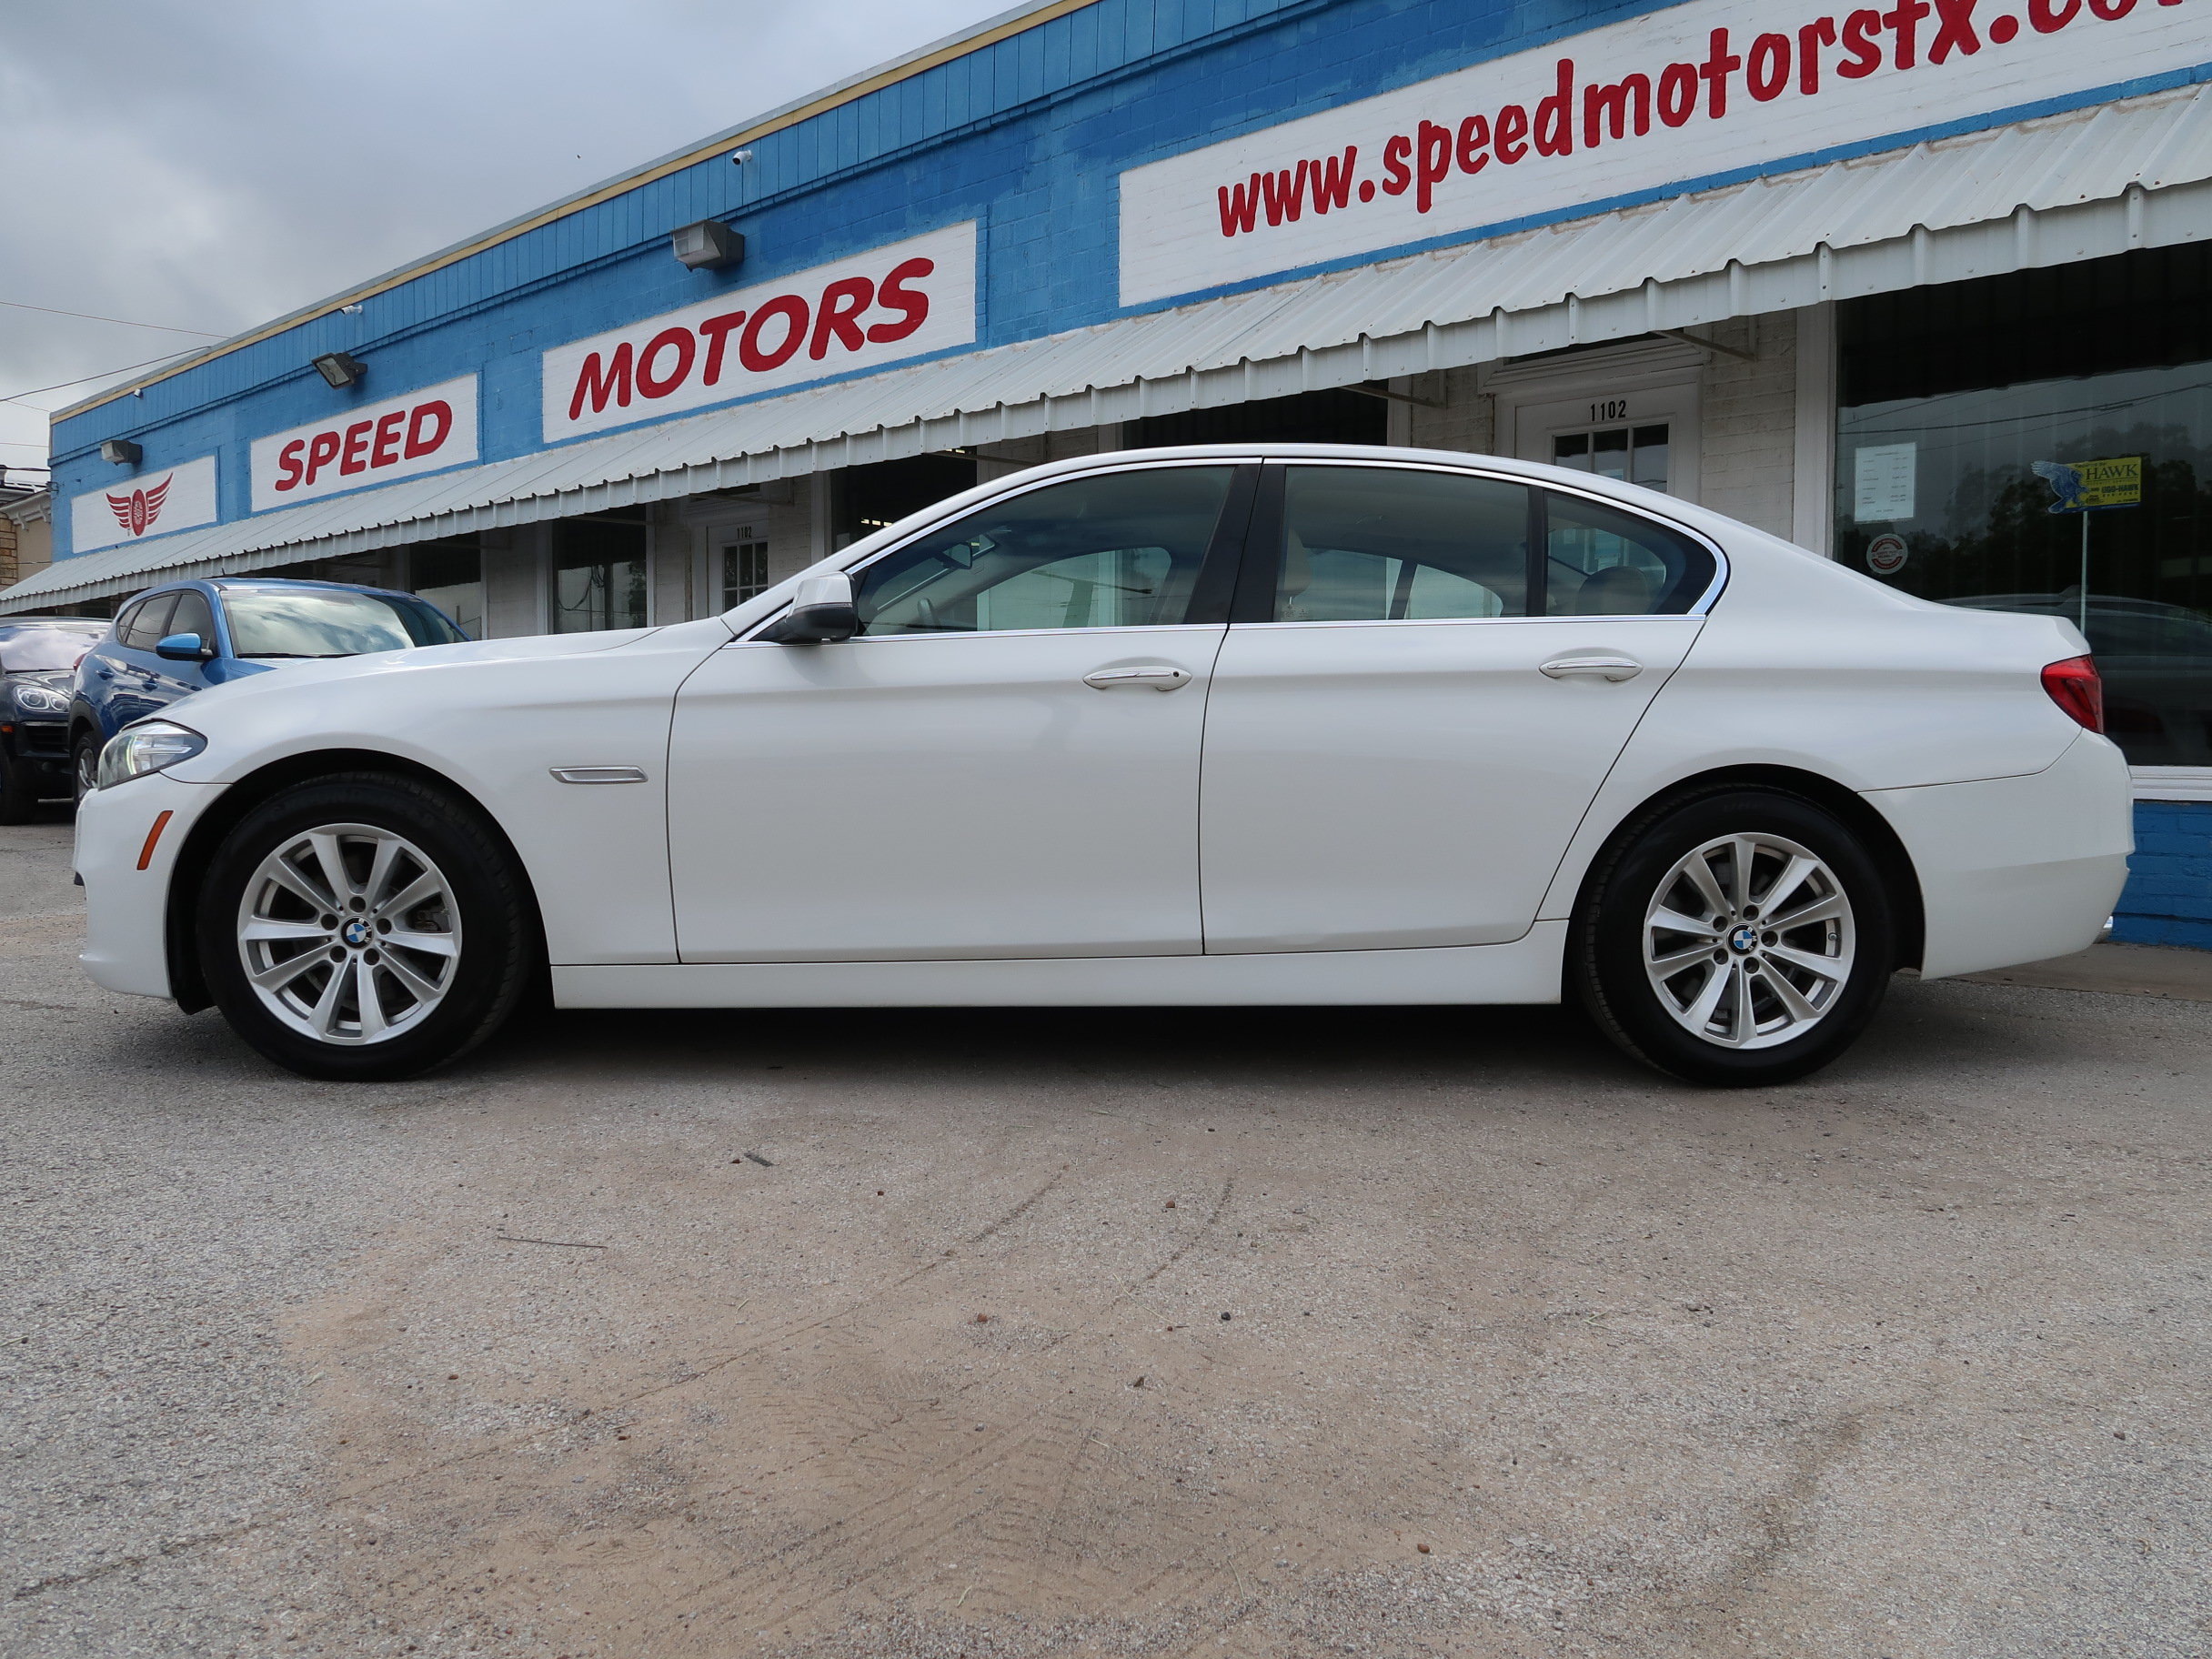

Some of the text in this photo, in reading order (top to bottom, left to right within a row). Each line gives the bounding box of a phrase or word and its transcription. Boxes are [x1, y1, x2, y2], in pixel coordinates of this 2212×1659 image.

[1218, 0, 2183, 236] www.speedmotorstx.
[568, 257, 934, 420] MOTORS
[1591, 400, 1626, 421] 1102
[275, 399, 453, 492] SPEED
[2086, 464, 2138, 480] HAWK
[737, 526, 752, 539] 1102
